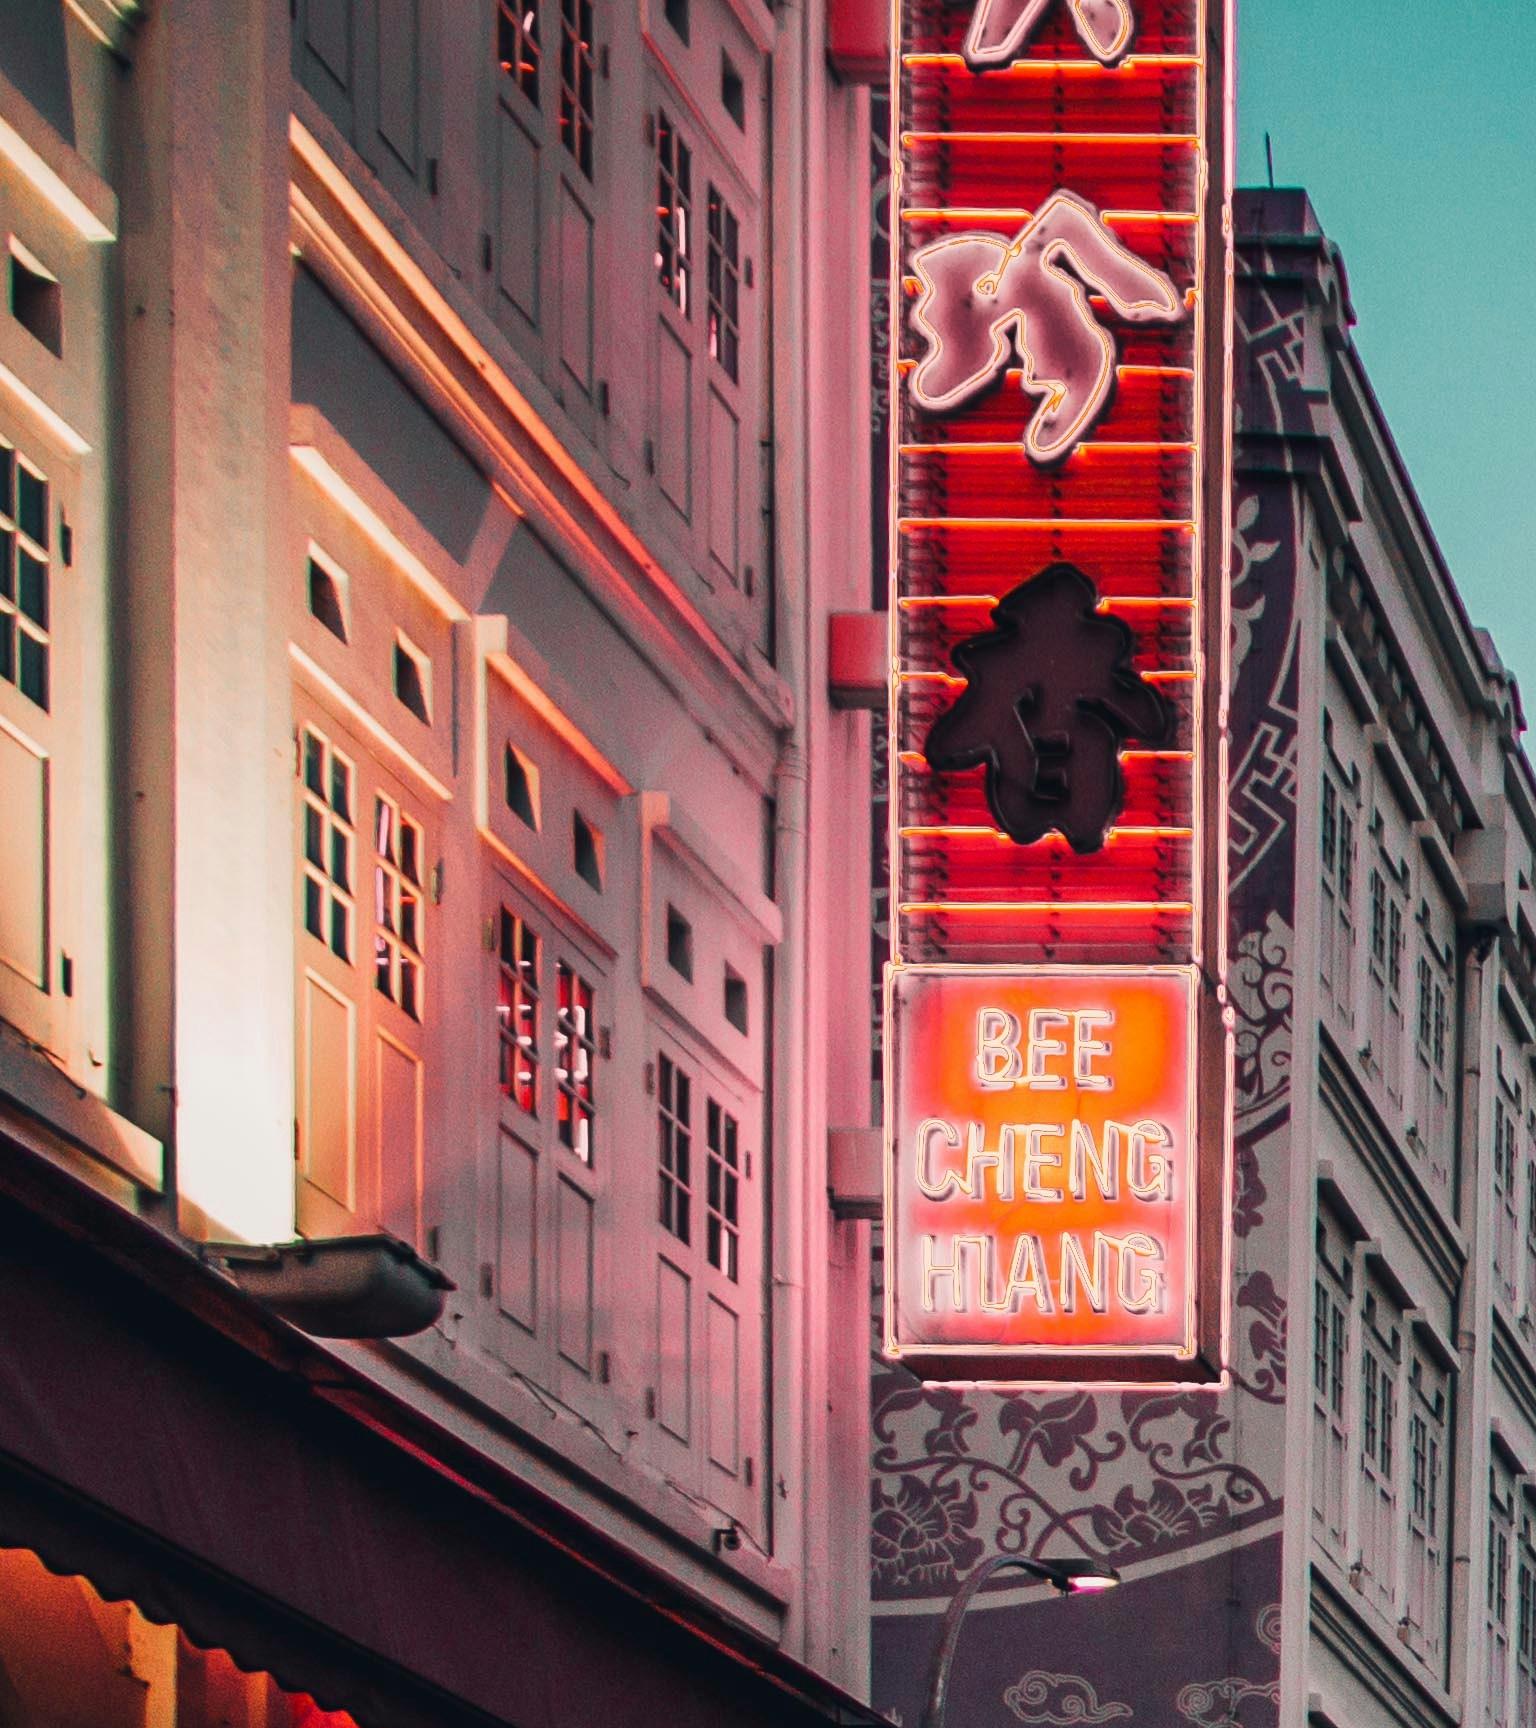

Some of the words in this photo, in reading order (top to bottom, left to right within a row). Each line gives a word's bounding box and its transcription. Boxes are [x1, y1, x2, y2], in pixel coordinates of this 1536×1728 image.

[908, 0, 1180, 853] 珍香
[973, 1006, 1114, 1091] BEE
[914, 1116, 1172, 1203] CHENG
[918, 1235, 1165, 1317] HIANG
